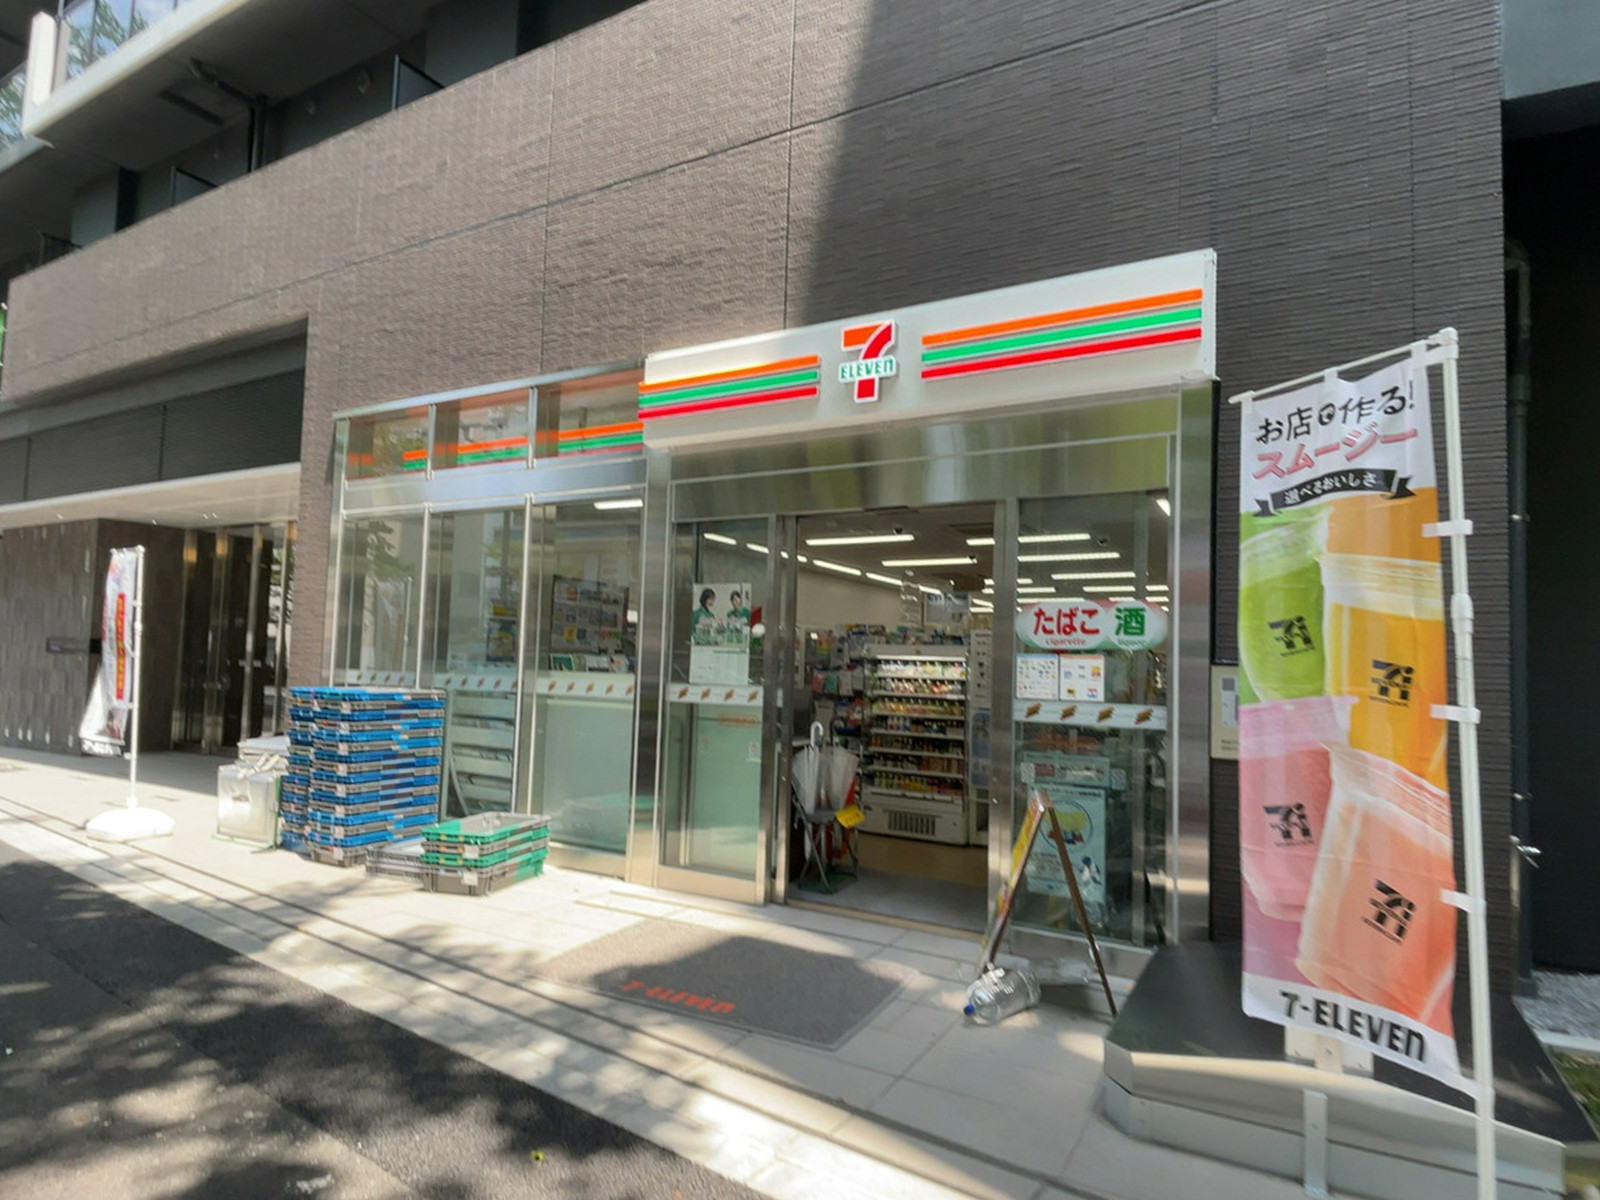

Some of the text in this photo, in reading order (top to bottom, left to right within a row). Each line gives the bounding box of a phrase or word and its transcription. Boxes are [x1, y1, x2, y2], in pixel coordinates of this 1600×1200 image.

[842, 322, 893, 401] 7
[1253, 422, 1418, 480] スムージー
[1033, 606, 1100, 636] たばこ
[1114, 607, 1146, 637] 酒
